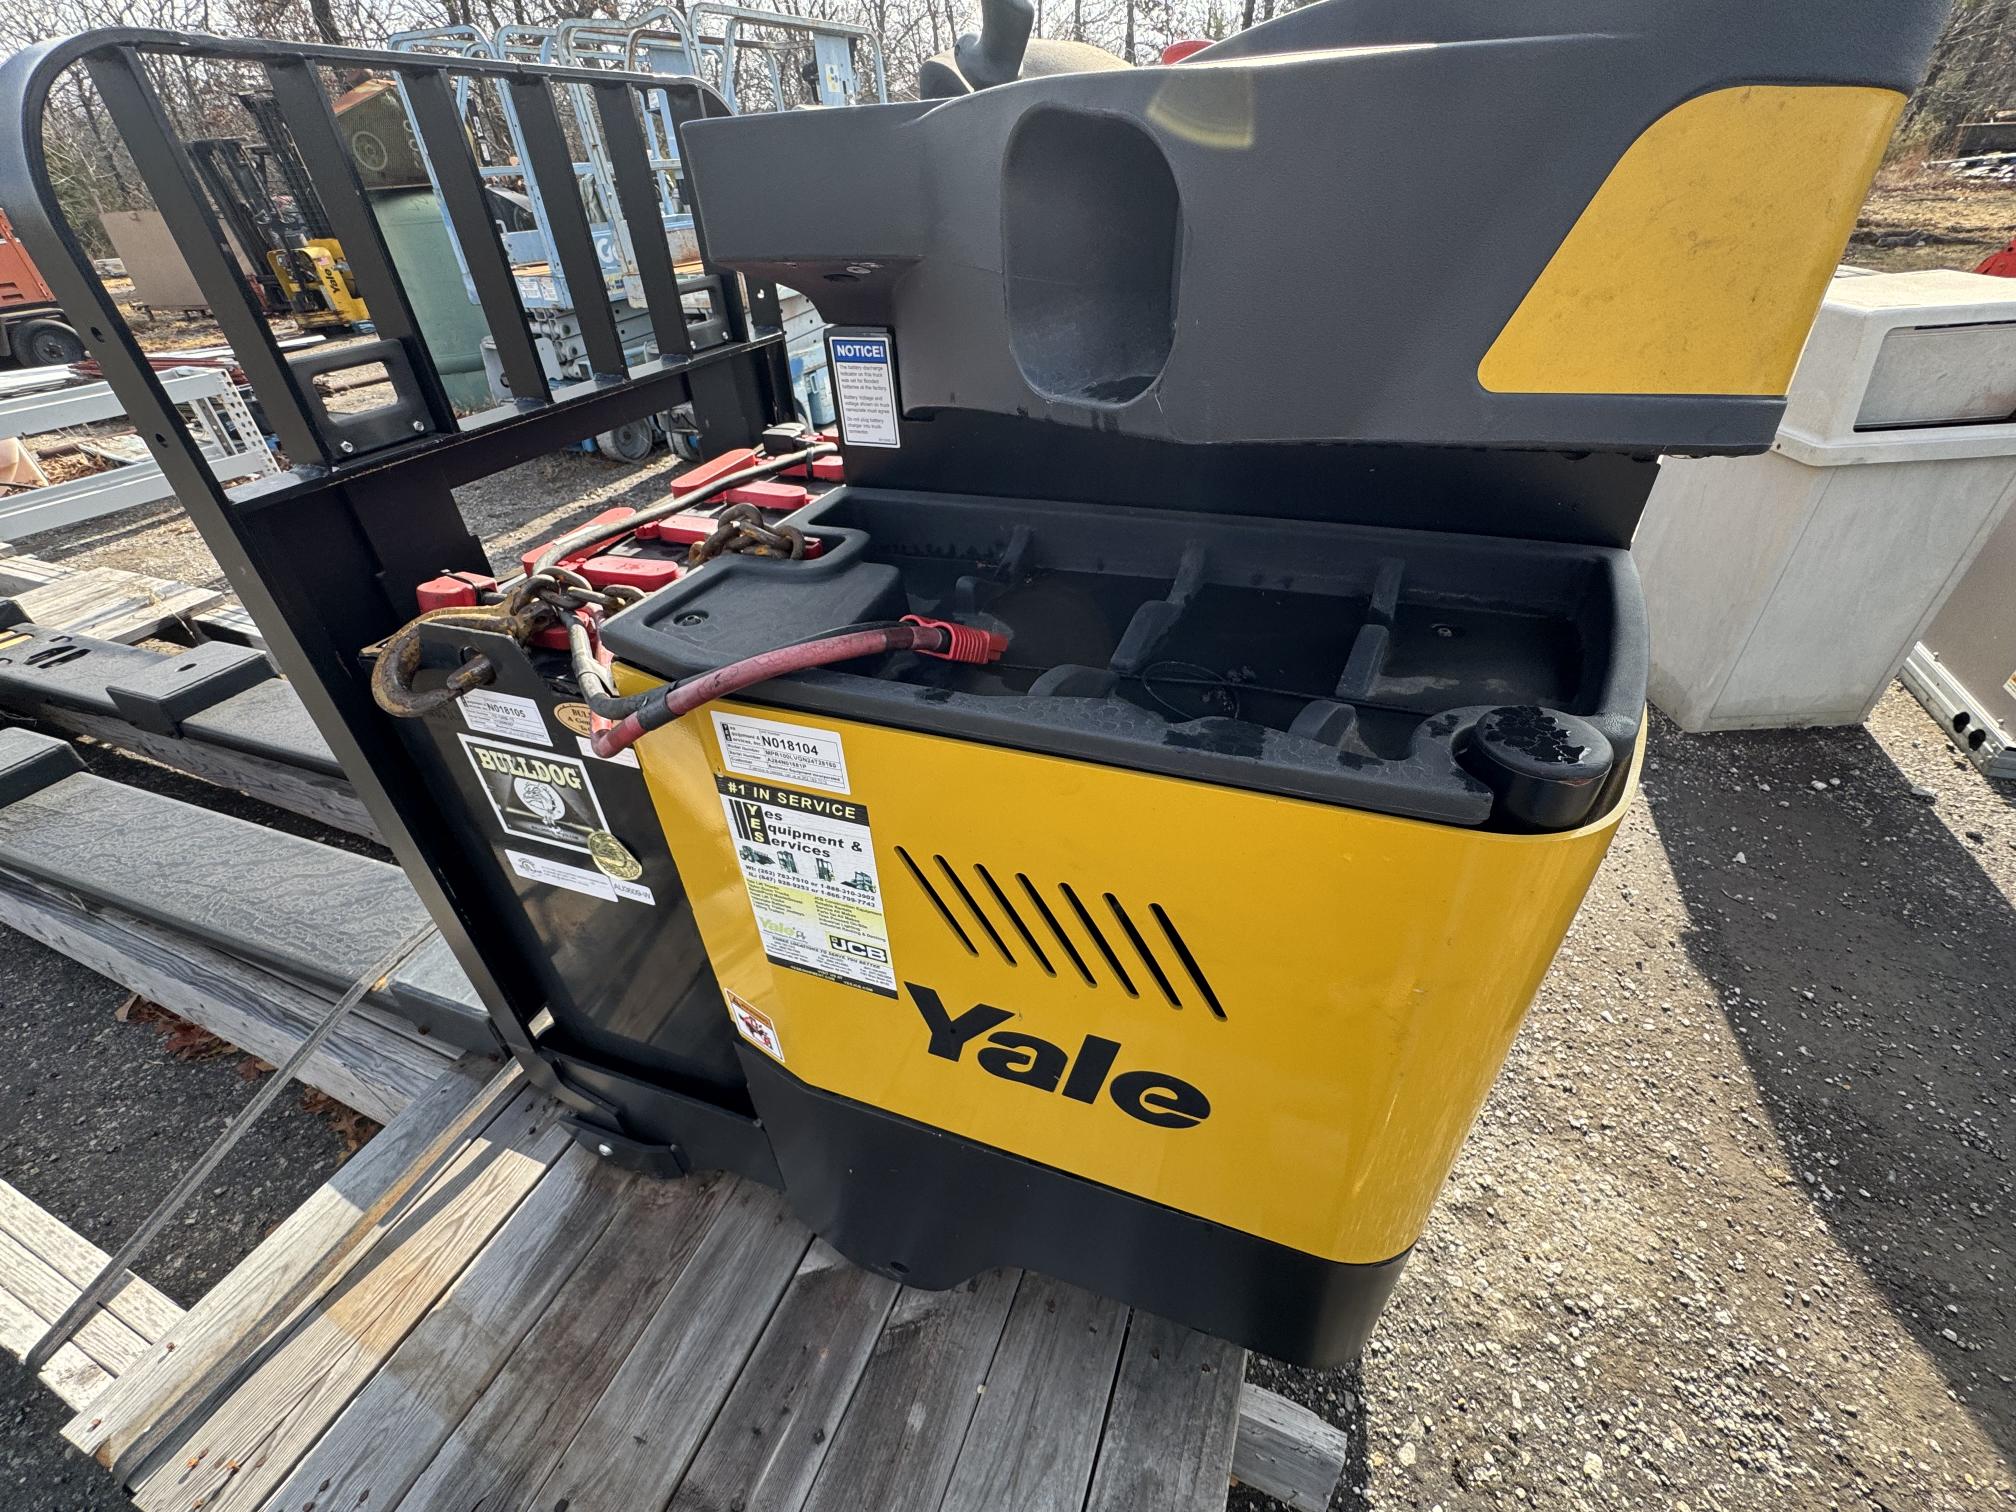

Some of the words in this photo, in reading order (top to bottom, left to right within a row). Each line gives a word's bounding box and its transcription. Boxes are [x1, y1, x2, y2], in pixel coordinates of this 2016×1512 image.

[324, 268, 340, 294] Yale
[836, 345, 884, 358] NOTICE!
[486, 703, 526, 718] N018105
[761, 735, 819, 755] N018104
[474, 748, 582, 790] BULLDOG
[728, 781, 745, 795] #1
[753, 787, 770, 800] IN
[777, 792, 856, 819] SERVICE
[851, 841, 862, 852] &
[831, 936, 886, 962] JCB
[903, 981, 1212, 1129] Yale
